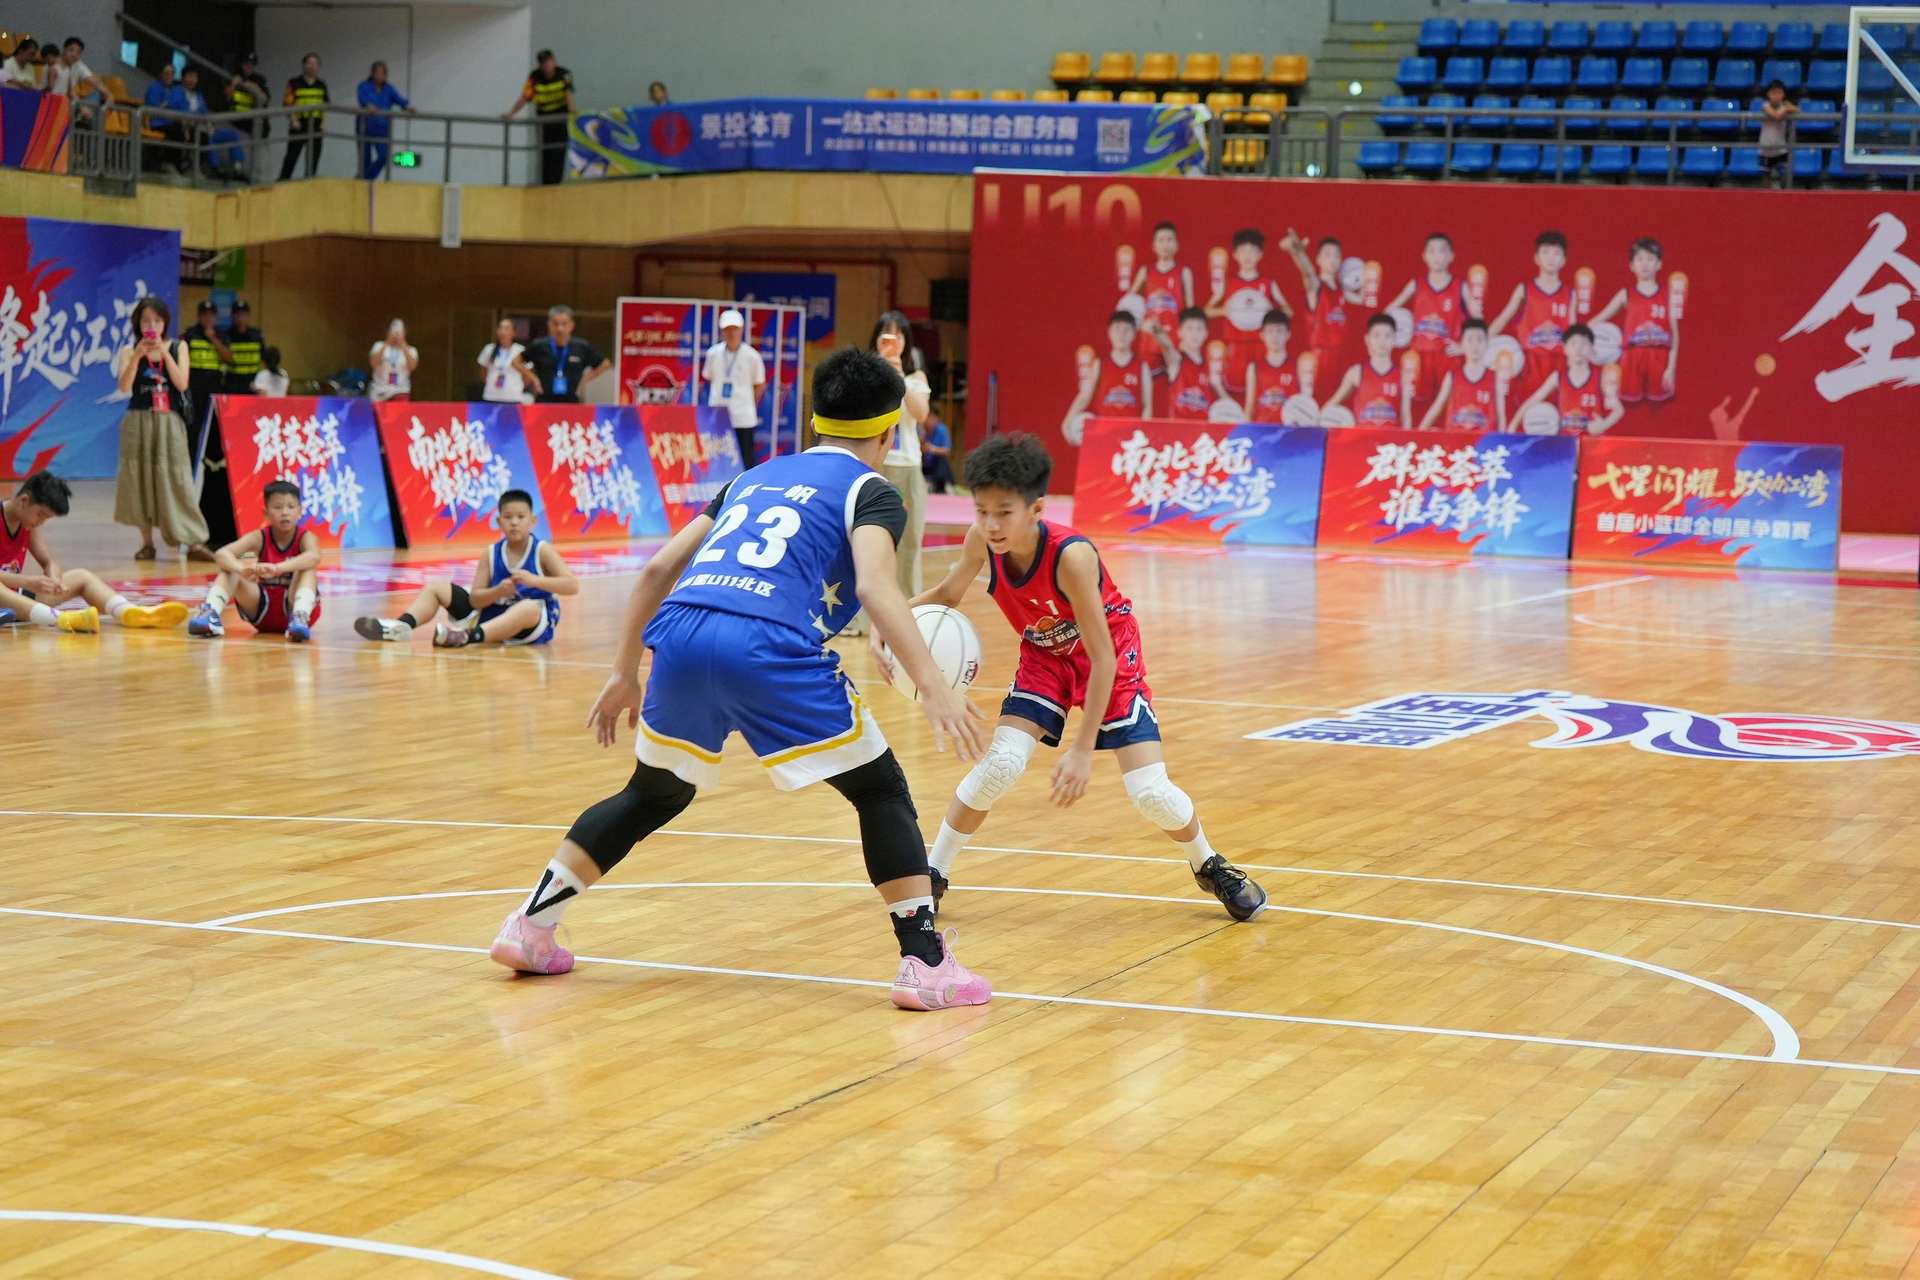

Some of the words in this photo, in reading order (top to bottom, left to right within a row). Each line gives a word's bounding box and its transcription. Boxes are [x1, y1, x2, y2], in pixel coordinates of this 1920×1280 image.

[1111, 429, 1254, 484] 南北争冠
[1355, 441, 1513, 492] 群英荟萃
[276, 464, 365, 528] 与争锋
[1379, 485, 1532, 541] 谁与争锋
[692, 503, 802, 569] 23
